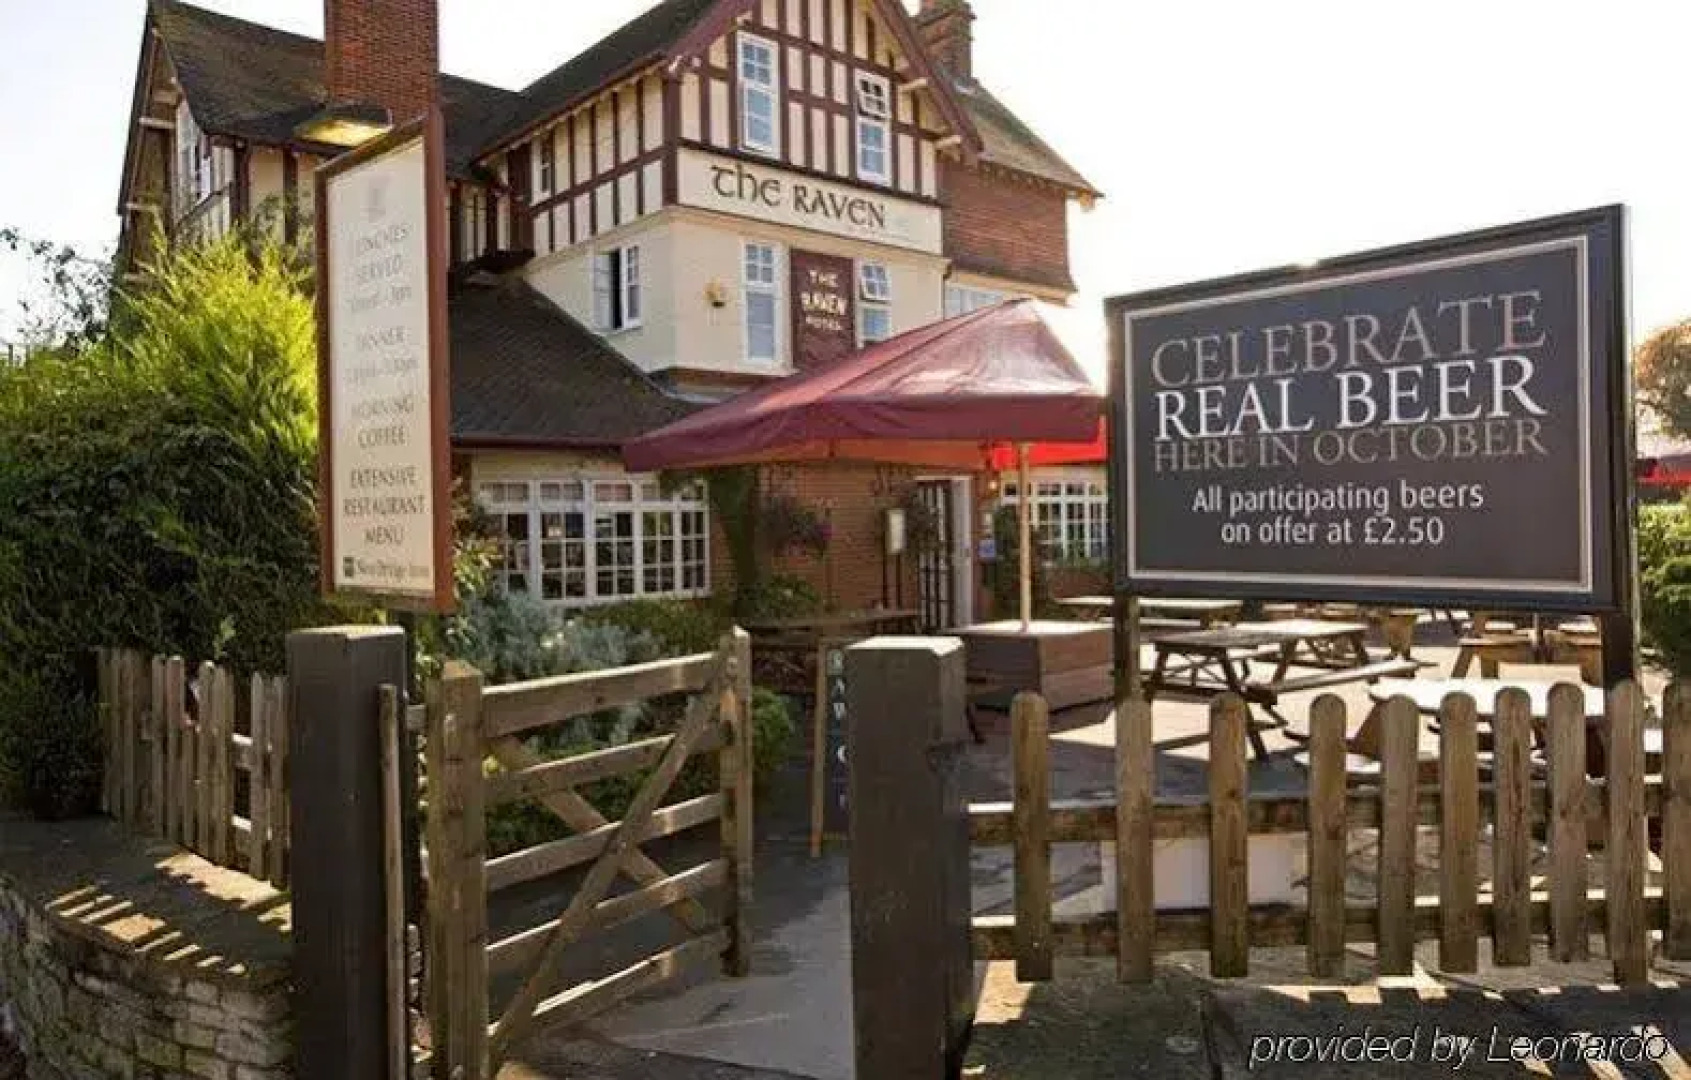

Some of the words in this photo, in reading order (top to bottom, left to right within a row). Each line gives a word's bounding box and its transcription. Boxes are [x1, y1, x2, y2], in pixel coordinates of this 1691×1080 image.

[809, 269, 838, 288] THE
[1151, 290, 1547, 388] CELEBRATE
[1154, 377, 1314, 442] REAL
[1335, 355, 1548, 430] BEER
[357, 425, 406, 449] COFFEE
[1154, 435, 1245, 473] HERE
[1258, 433, 1300, 467] IN
[1313, 418, 1548, 465] OCTOBER
[350, 467, 417, 489] EXTENSIVE
[343, 495, 425, 518] RESTAURANT
[1192, 484, 1222, 513] All
[1230, 481, 1390, 518] participating
[1400, 479, 1485, 509] beers
[364, 526, 405, 547] MENU
[1221, 521, 1251, 545] on
[1259, 517, 1316, 545] offer
[1327, 519, 1354, 544] at
[1364, 516, 1445, 546] £2.50
